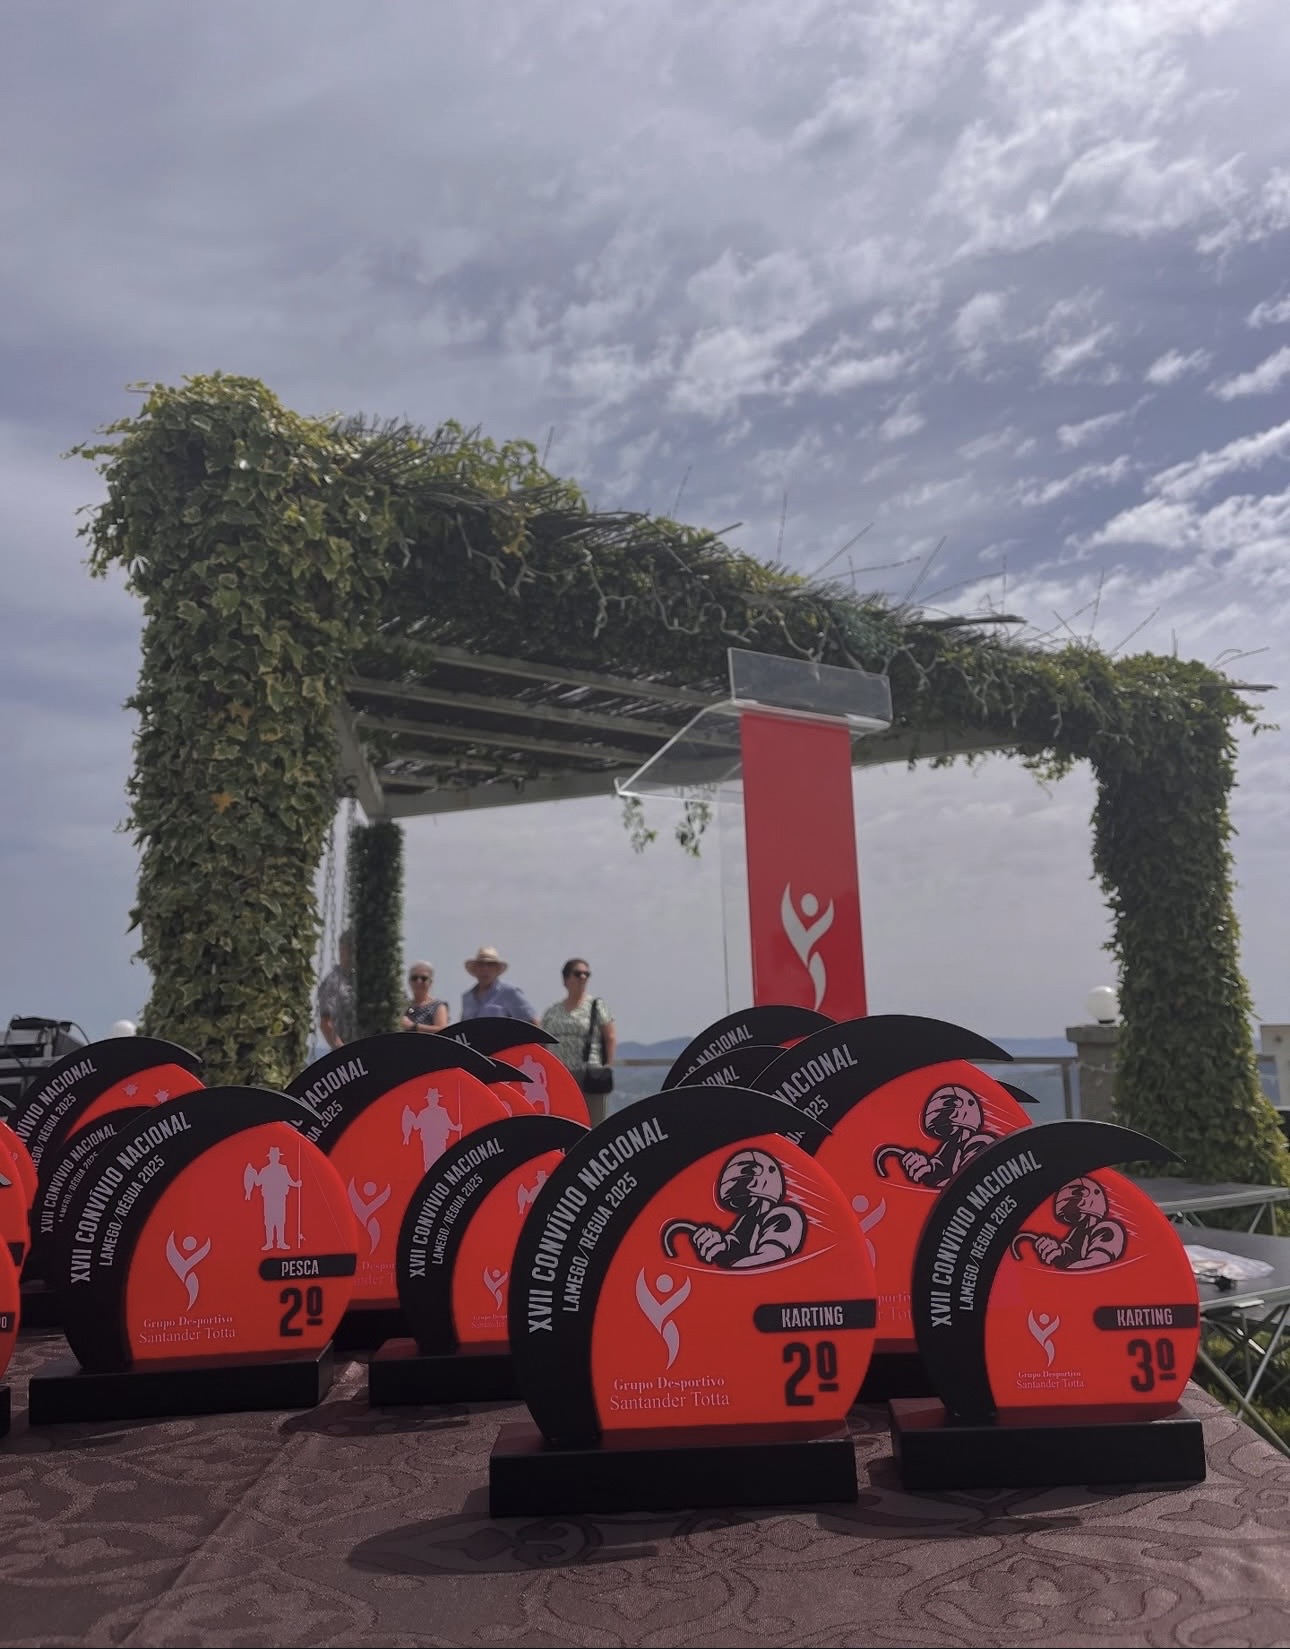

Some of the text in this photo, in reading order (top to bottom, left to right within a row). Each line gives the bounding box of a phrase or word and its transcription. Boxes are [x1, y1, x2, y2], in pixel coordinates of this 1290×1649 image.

[38, 1058, 97, 1106] NACIONAL
[55, 1092, 77, 1116] 2025
[41, 1210, 54, 1233] XVII
[69, 1123, 118, 1162] NACIONAL
[71, 1111, 192, 1284] XVII CONVÍVIO NACIONAL
[99, 1154, 165, 1266] LAMEGO/RÉGUA 2025
[409, 1138, 504, 1278] XVII CONVÍVIO NACIONAL
[432, 1172, 483, 1265] LAMEGO/RÉGUA 2025
[528, 1117, 669, 1333] XVII CONVÍVIO NACIONAL
[562, 1171, 638, 1312] LAMEGO/RÉGUA 2025
[930, 1150, 1042, 1328] XVII CONVÍVIO NACIONAL
[959, 1194, 1018, 1311] LAMEGO/RÉGUA 2025
[281, 1259, 320, 1277] PESCA
[138, 1327, 236, 1344] Santander Totta
[143, 1314, 233, 1331] Grupo Desportivo
[279, 1286, 323, 1338] 2º
[781, 1306, 844, 1328] KARTING
[1117, 1307, 1173, 1327] KARTING
[614, 1375, 725, 1394] Grupo Desportivo
[782, 1340, 839, 1407] 2º
[1016, 1378, 1085, 1390] Santander Totta
[1018, 1370, 1081, 1380] Grupo Desportivo
[1127, 1338, 1177, 1393] 3º
[610, 1391, 730, 1411] Santander Totta
